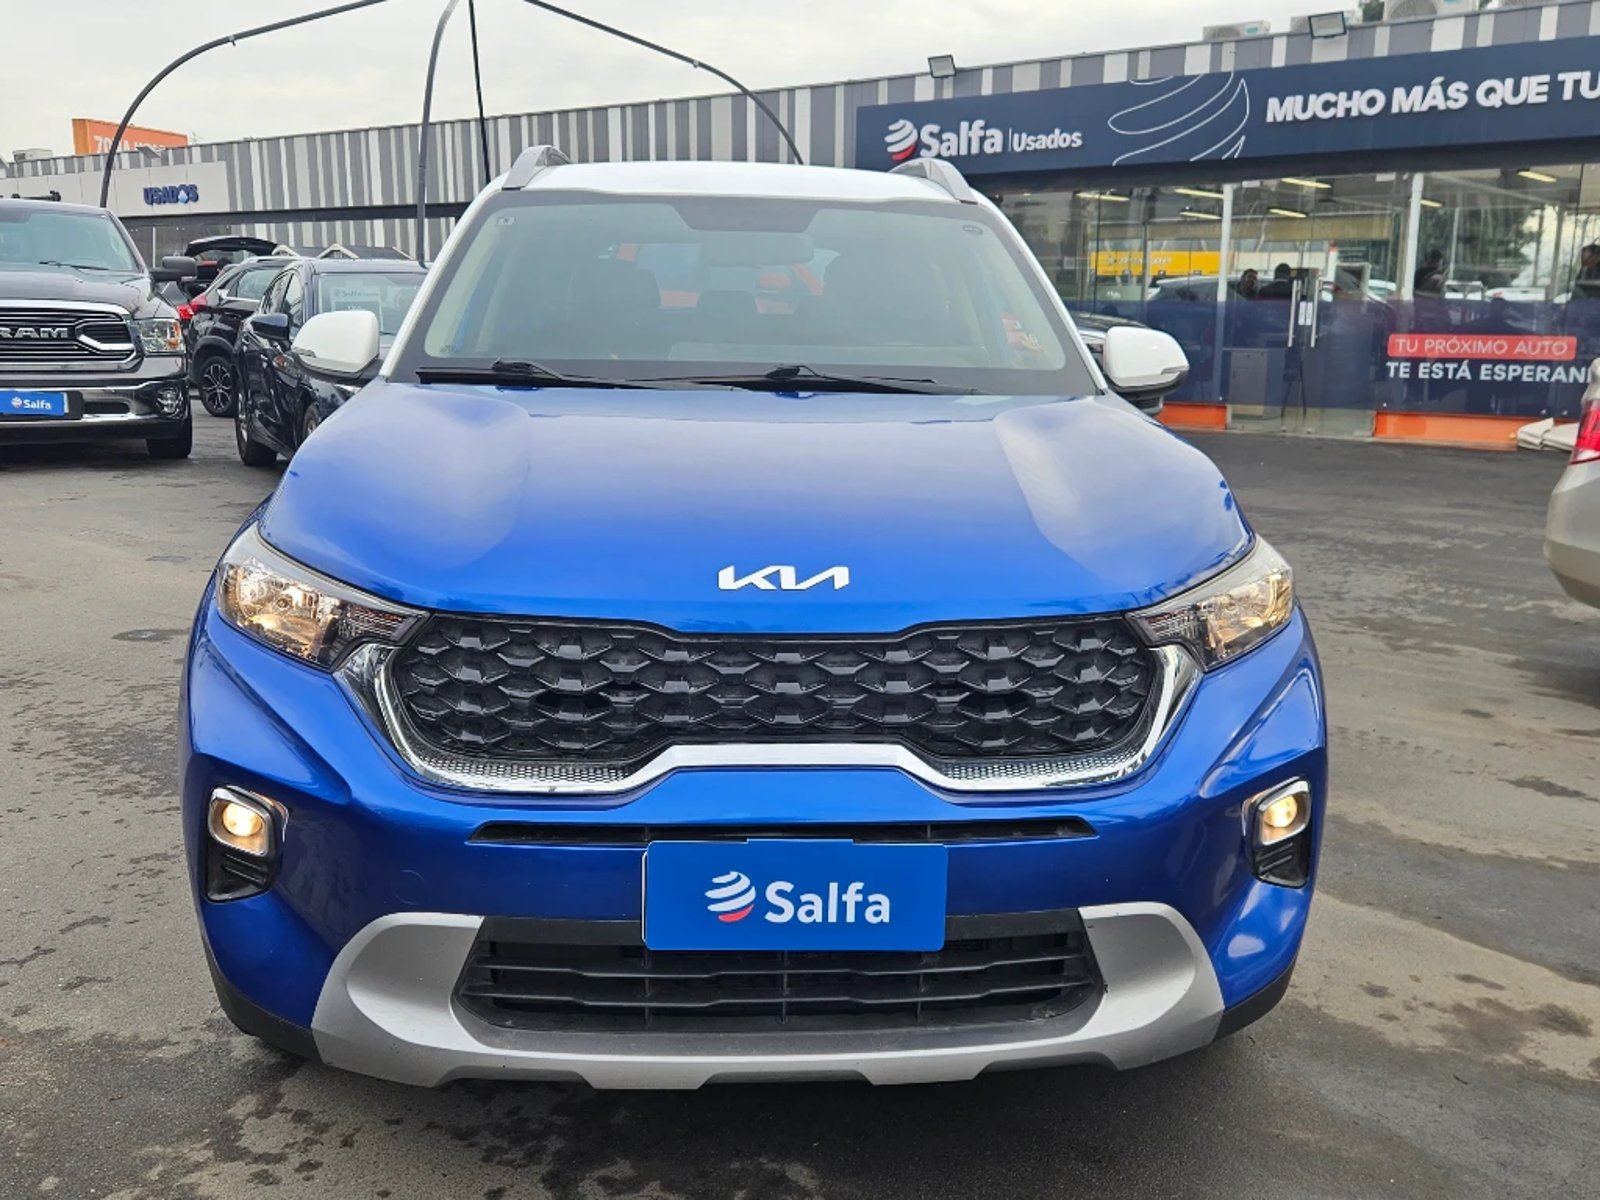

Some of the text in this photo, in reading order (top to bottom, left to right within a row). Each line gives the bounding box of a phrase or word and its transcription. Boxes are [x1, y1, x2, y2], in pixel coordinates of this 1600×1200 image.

[1266, 88, 1386, 123] MUCHO
[1391, 76, 1469, 114] MÁS
[1476, 75, 1551, 108] QUE
[919, 119, 1083, 159] Salfa Usados
[143, 184, 199, 205] USADOS
[1395, 336, 1569, 356] TU PRÓXIMO AUTO
[1386, 359, 1592, 384] TE ESTÁ ESPERAN
[23, 399, 52, 410] Salfa
[717, 565, 850, 590] KIA
[764, 880, 891, 923] Salfa
